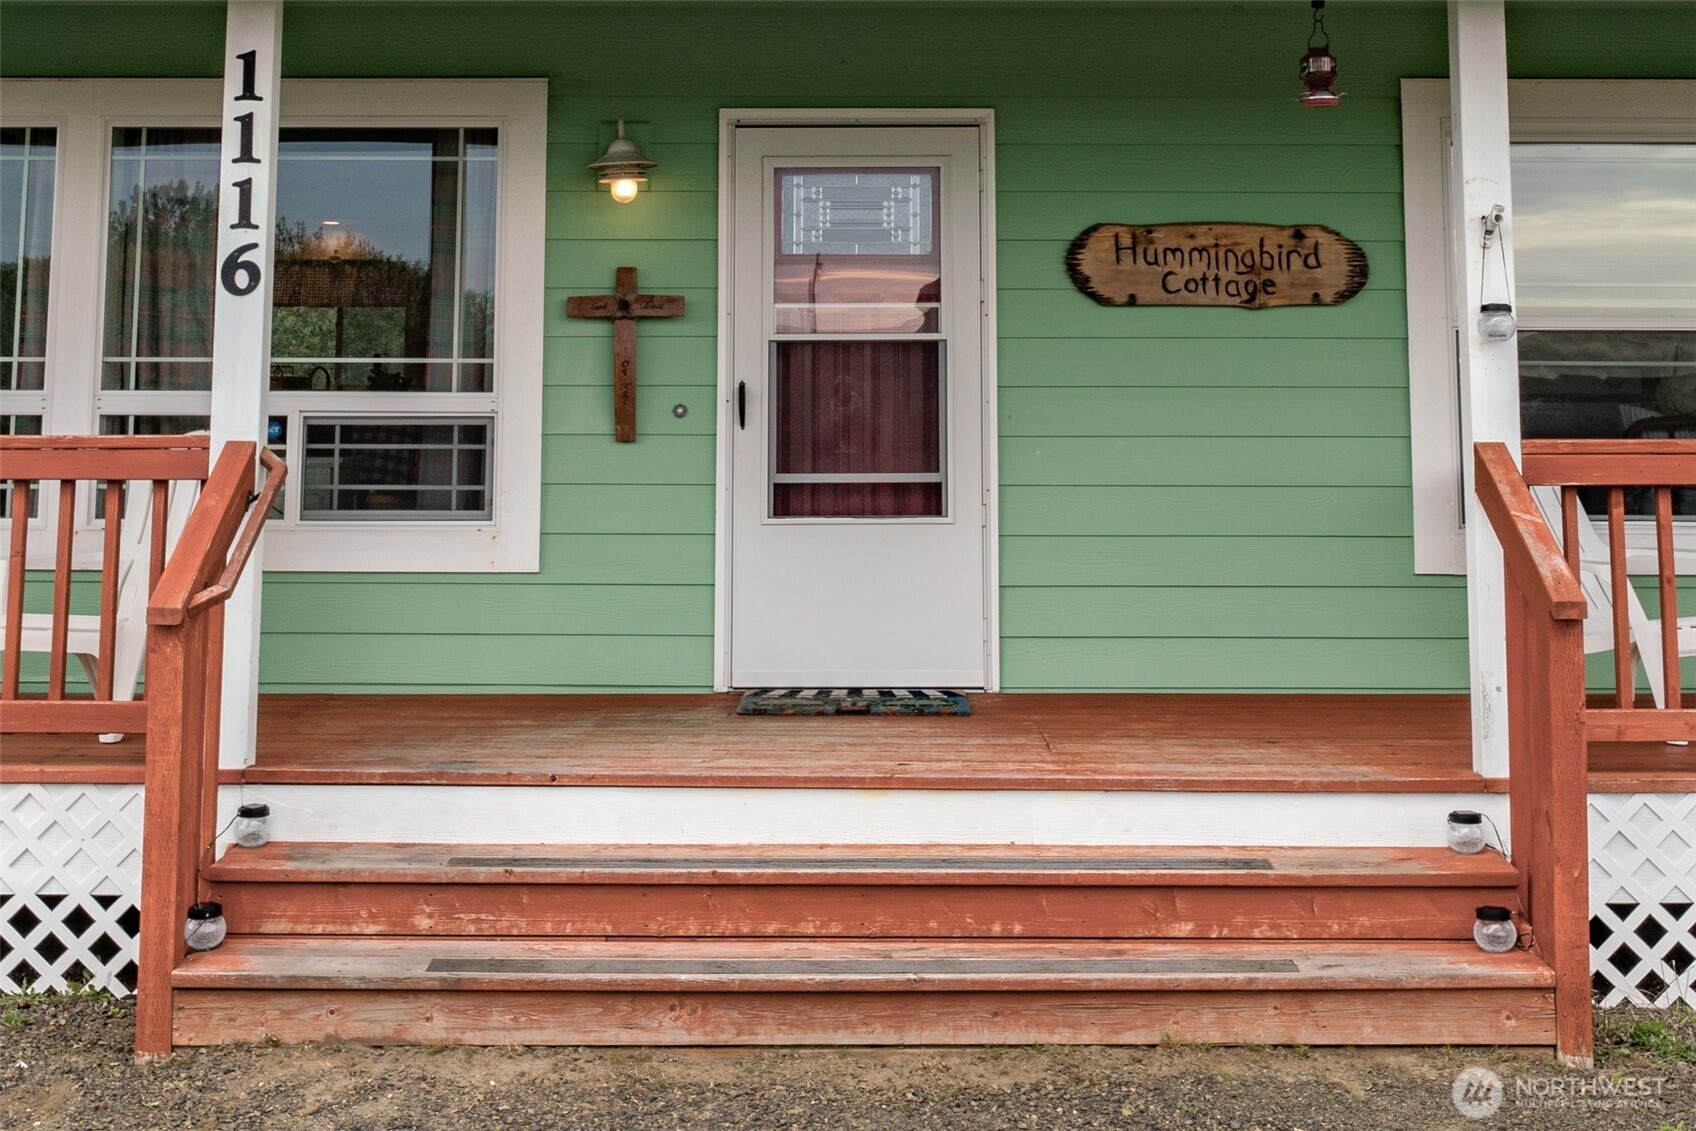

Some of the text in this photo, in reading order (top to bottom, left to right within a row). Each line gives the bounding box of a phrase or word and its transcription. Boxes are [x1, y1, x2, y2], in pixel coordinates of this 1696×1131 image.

[220, 49, 264, 297] 1116
[1114, 232, 1322, 275] Hummingbird
[1160, 270, 1277, 304] Cottage
